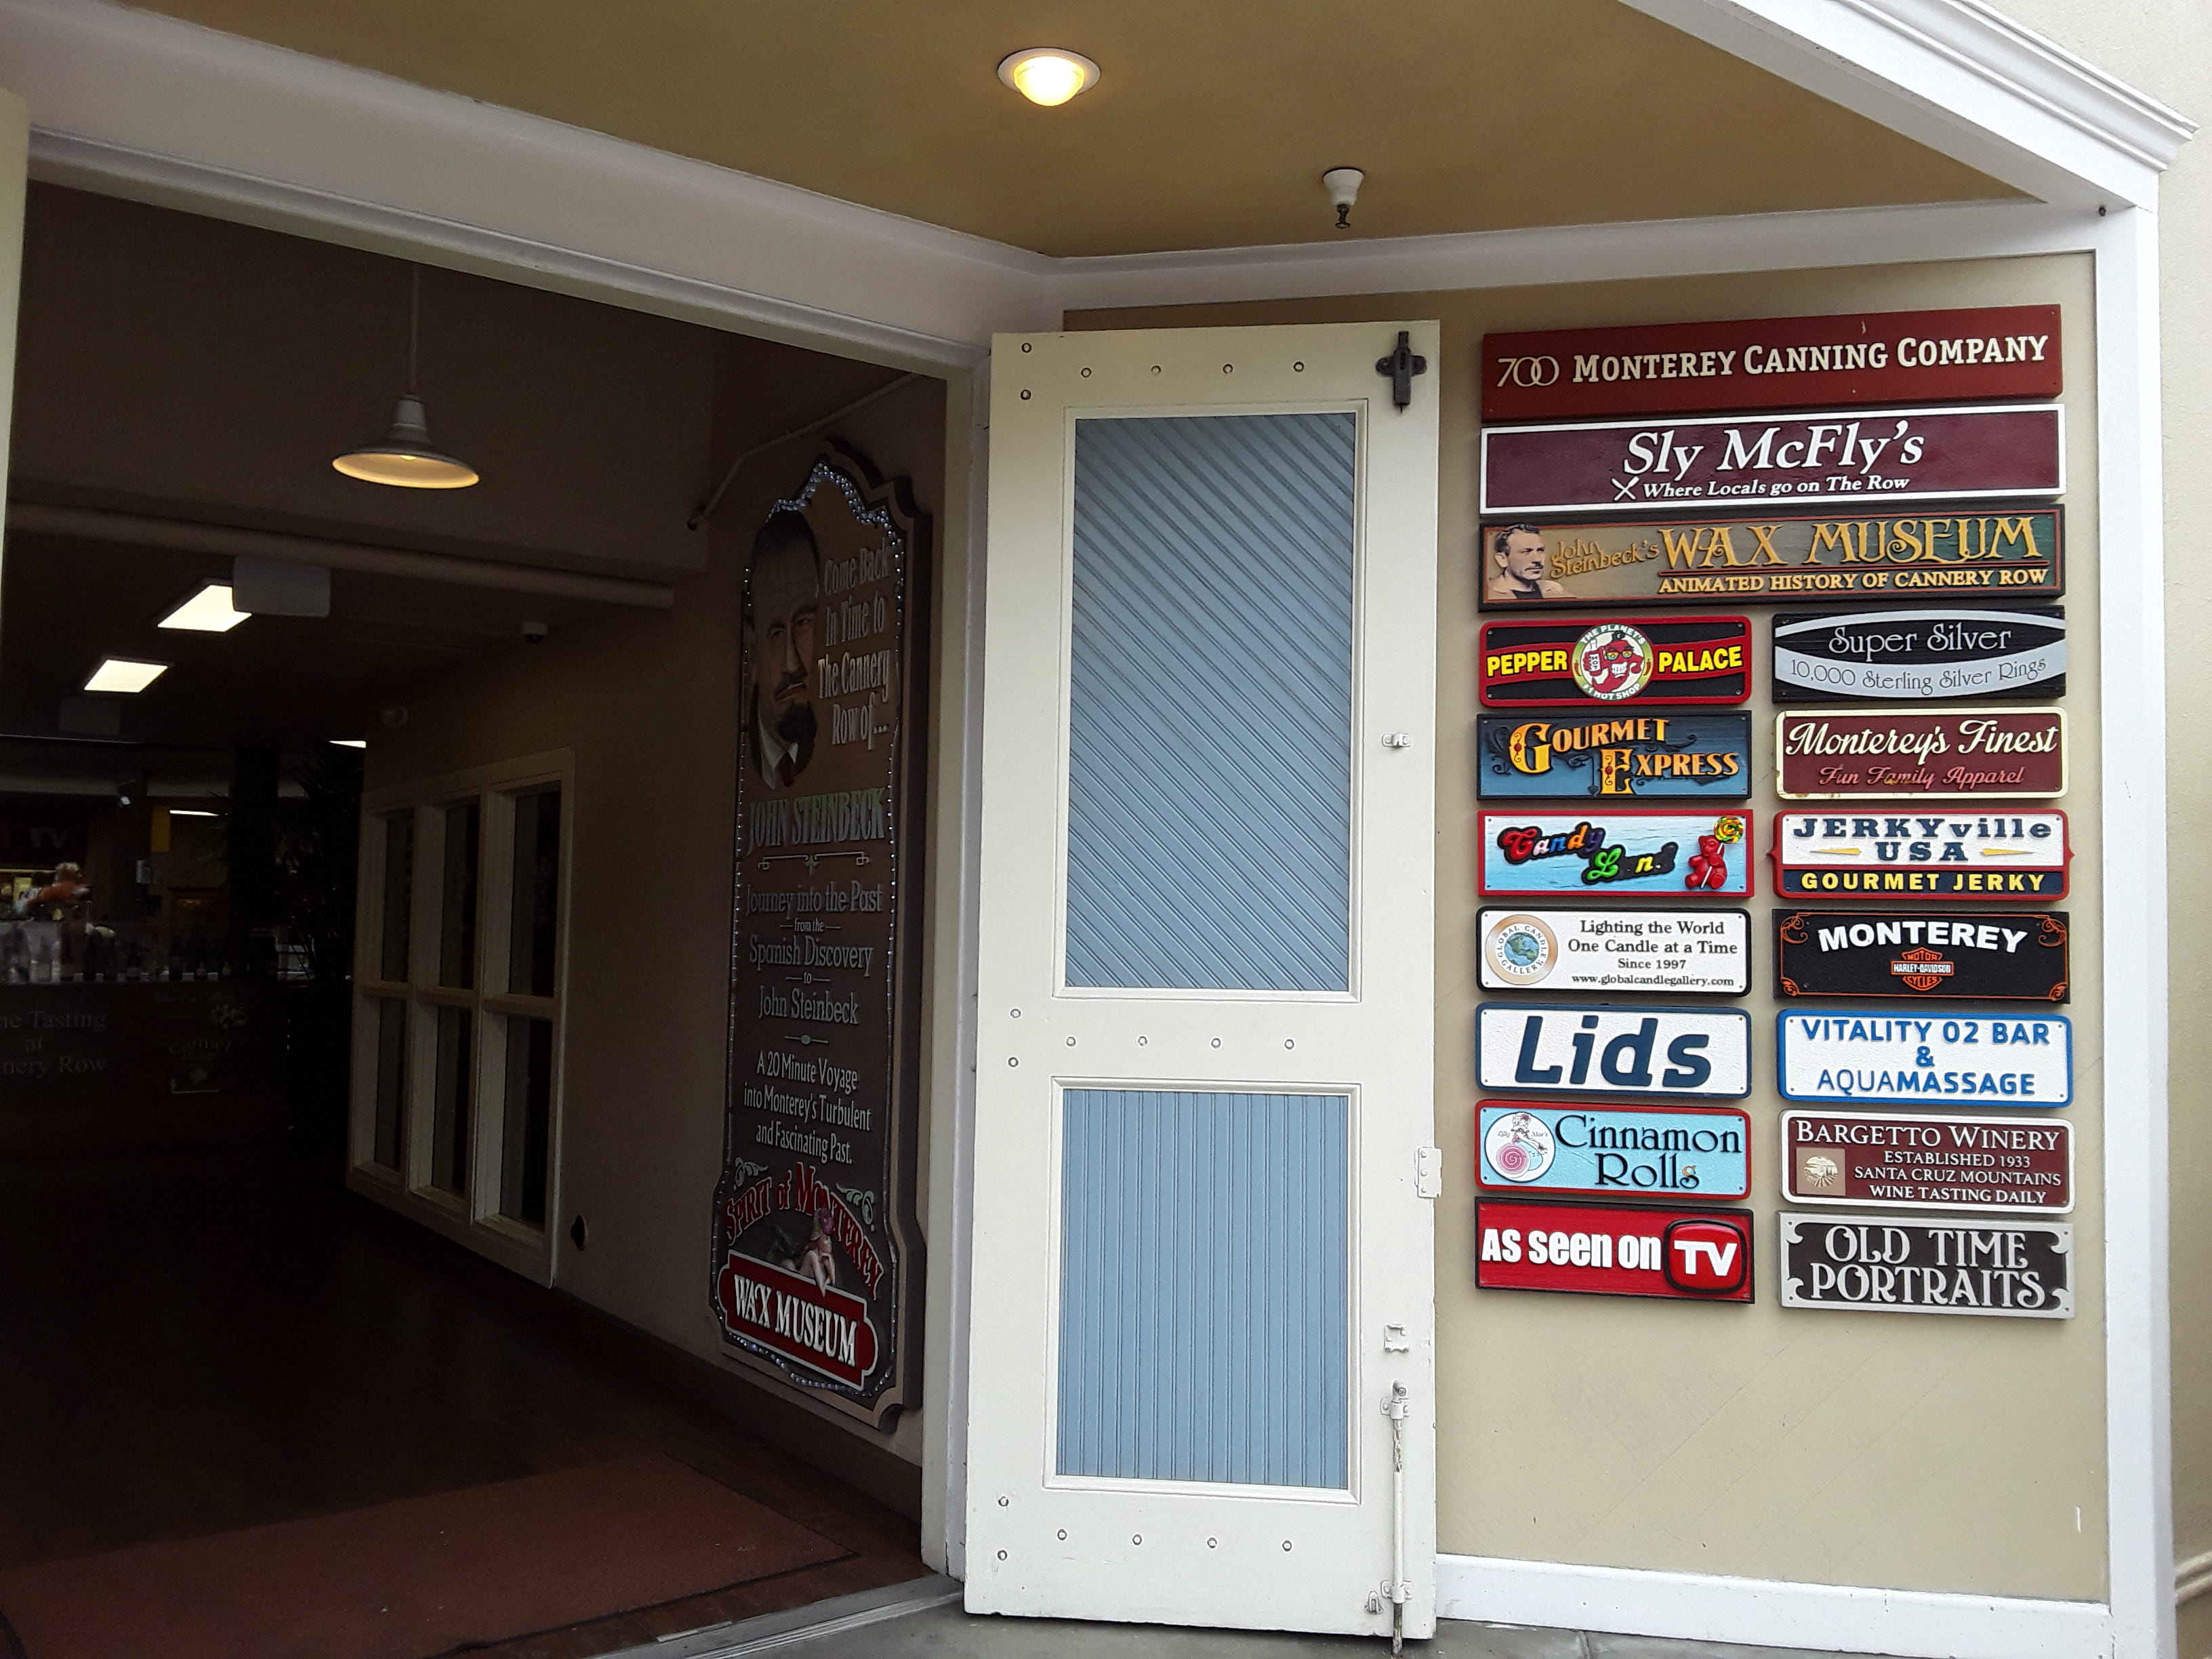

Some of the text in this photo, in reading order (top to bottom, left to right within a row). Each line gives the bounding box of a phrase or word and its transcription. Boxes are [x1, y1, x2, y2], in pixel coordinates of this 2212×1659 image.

[1497, 335, 2049, 388] 700 MONTEREY CANNING COMPANY
[1623, 421, 1925, 480] Sly McFly's
[1643, 475, 1910, 499] Where Locals go on The Row
[1550, 539, 1660, 579] Steinbeck's
[1555, 538, 1601, 560] John
[1658, 516, 2044, 571] WAX MUSEUM
[824, 537, 888, 596] Come Back
[1658, 567, 2048, 595] ANIMATED HISTORY OF CANNERY ROW
[825, 590, 884, 647] In Time to
[1580, 624, 1646, 644] THE PLANET'S
[1828, 623, 2012, 661] Super Silver
[817, 650, 889, 703] The Cannery
[1487, 646, 1743, 678] PEPPER PALACE
[1790, 656, 2047, 696] 10,000 Sterling Silver Rings
[1593, 691, 1615, 700] HOT
[1616, 683, 1640, 699] SHOP
[832, 703, 859, 744] Row
[1508, 718, 1670, 775] GOURMET
[1785, 719, 2060, 765] Monterey's Finest
[1599, 749, 1740, 795] EXPRESS
[1819, 766, 2024, 791] Fun Family Apparel
[747, 787, 885, 855] JOHN STEINBECK
[1793, 818, 2052, 838] JERKYville
[1502, 824, 1603, 860] Candy
[1875, 841, 1969, 862] USA
[1801, 873, 2045, 891] GOURMET JERKY
[746, 880, 883, 920] Journey into the Past
[794, 918, 824, 932] from the
[1496, 925, 1547, 958] GLOBAL CANDLE
[1580, 920, 1725, 936] Lighting the World
[1817, 921, 2028, 954] MONTEREY
[750, 933, 873, 977] Spanish Discovery
[1568, 939, 1738, 954] One Candle at a Time
[1907, 950, 1938, 960] MOTOR
[803, 972, 812, 984] to
[1501, 960, 1542, 974] GALLERY
[1571, 974, 1734, 987] www.globalcandlegallery.com
[1618, 958, 1687, 970] Since 1997
[1893, 963, 1951, 973] HARLEY-DAVIDSON
[1907, 976, 1938, 987] CYCLES
[28, 1010, 107, 1032] Tasting
[758, 985, 859, 1025] John Steinbeck
[1801, 1019, 1932, 1042] VITALITY
[1992, 1023, 2050, 1044] BAR
[58, 1055, 108, 1073] Row
[1515, 1015, 1711, 1088] Lids
[1916, 1046, 1936, 1067] &
[756, 1049, 857, 1095] A 20 Minute Voyage
[1817, 1069, 2035, 1095] AQUAMASSAGE
[744, 1081, 872, 1132] into Monterey's Turbulent
[756, 1120, 853, 1165] and Fascinating Past.
[1555, 1115, 1742, 1153] Cinnamon
[1796, 1120, 2060, 1151] BARGETTO WINERY
[1595, 1153, 1700, 1189] Rolls
[1884, 1151, 2030, 1167] ESTABLISHED 1933
[1854, 1166, 2061, 1186] SANTA CRUZ MOUNTAINS
[725, 1176, 773, 1246] SPIRIT
[777, 1170, 792, 1210] of
[1869, 1185, 2046, 1204] WINE TASTING DAILY
[1528, 1230, 1613, 1268] seen
[1617, 1235, 1662, 1271] on
[1673, 1240, 1738, 1277] TV
[1825, 1226, 2029, 1267] OLD TIME
[1811, 1264, 2045, 1308] PORTRAITS
[734, 1274, 857, 1368] WAX MUSEUM
